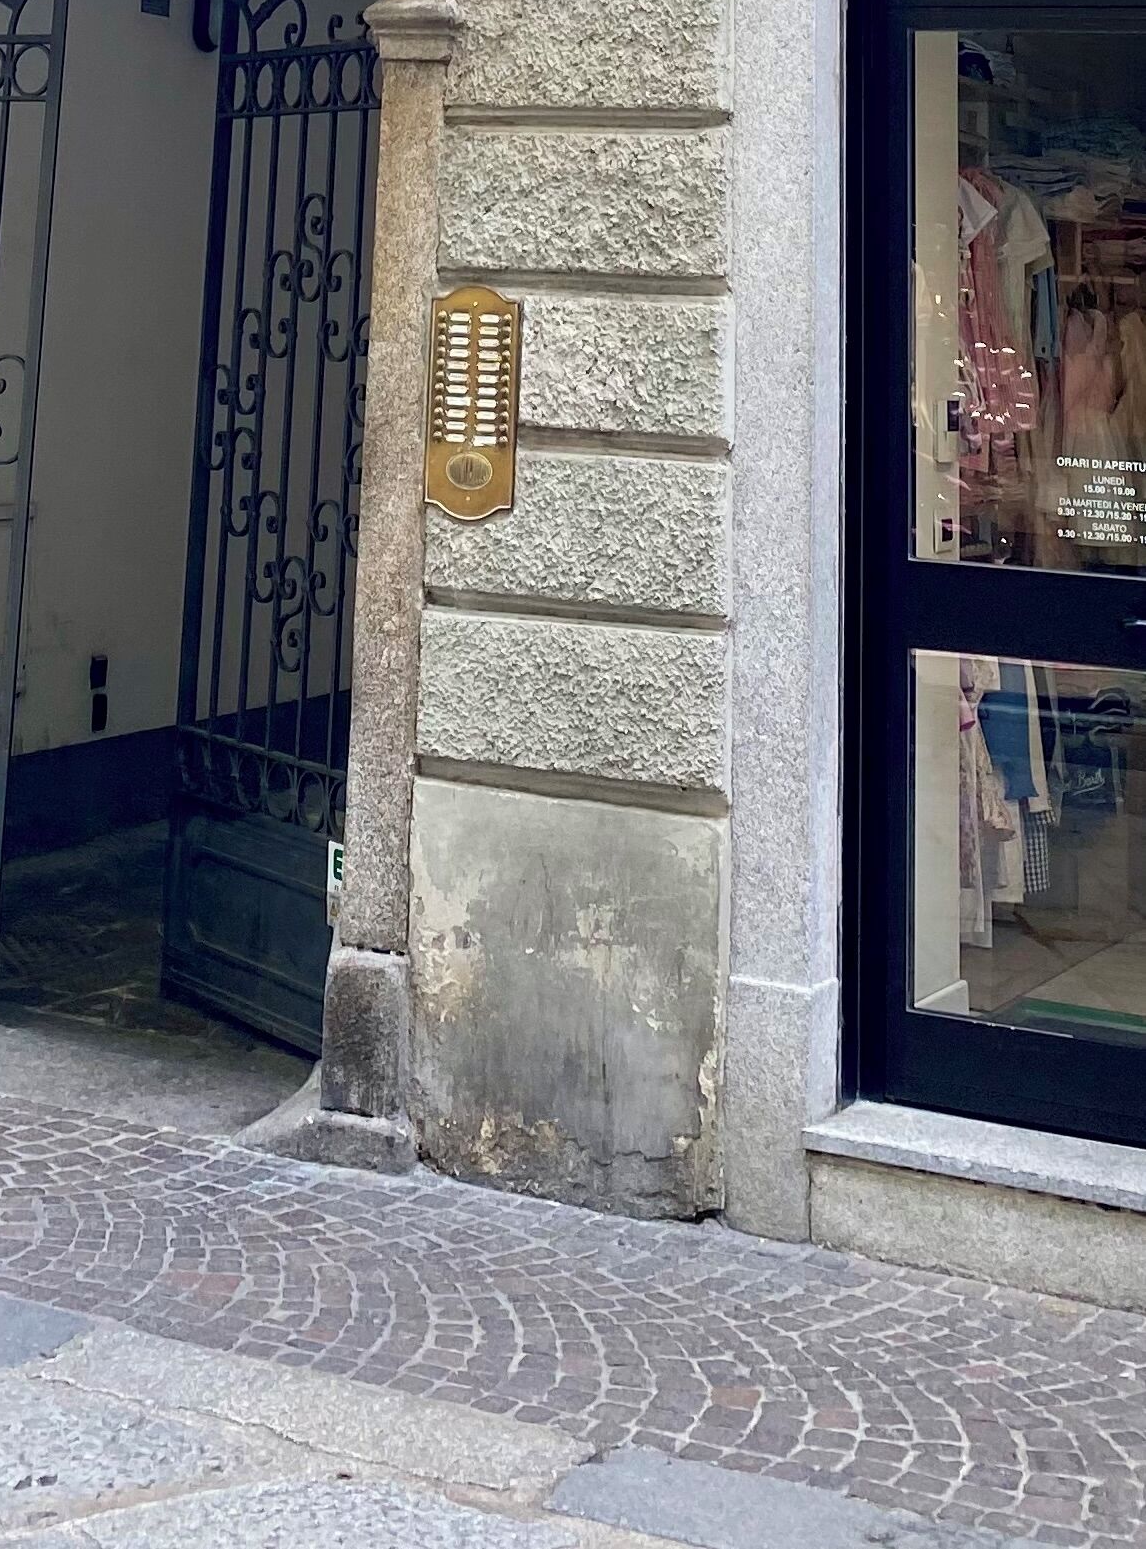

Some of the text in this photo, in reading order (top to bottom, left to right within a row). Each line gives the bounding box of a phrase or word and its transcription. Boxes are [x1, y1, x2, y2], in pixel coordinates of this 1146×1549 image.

[1056, 456, 1090, 469] ORARI
[1091, 459, 1103, 470] DI
[1083, 484, 1106, 494] 15.00
[1058, 497, 1072, 507] DA
[1113, 501, 1121, 510] A
[1120, 501, 1146, 512] VENE
[1057, 507, 1075, 517] 9.30
[1091, 522, 1128, 533] SABATO
[1057, 528, 1076, 539] 9.30
